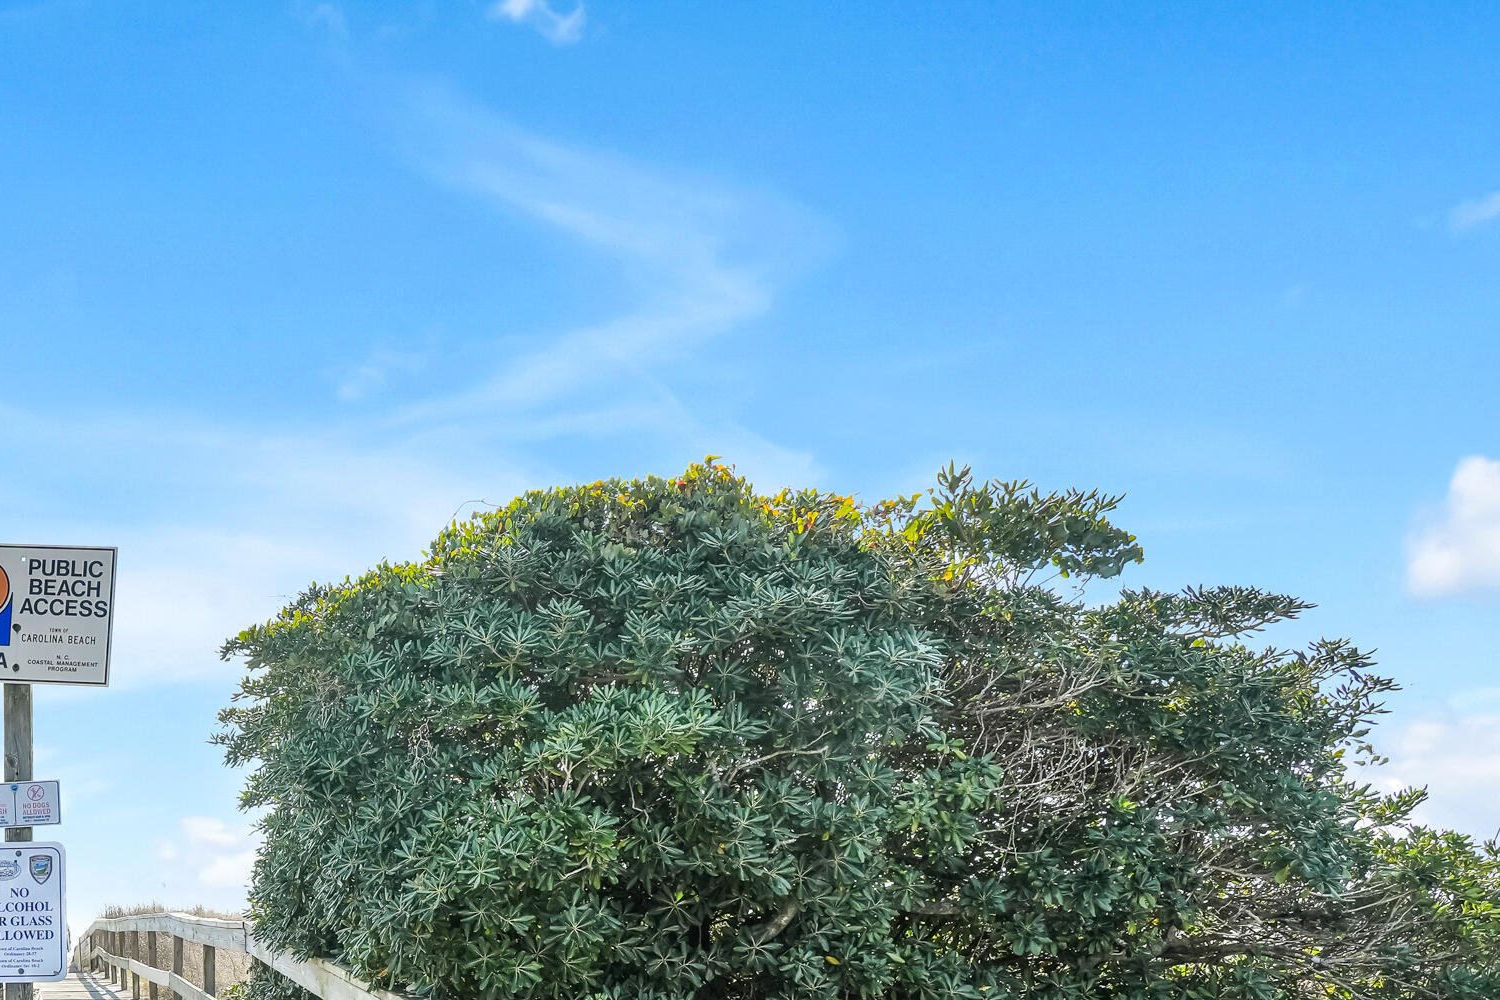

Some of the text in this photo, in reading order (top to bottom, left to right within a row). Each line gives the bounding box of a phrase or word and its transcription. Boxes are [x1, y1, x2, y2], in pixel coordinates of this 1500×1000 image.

[28, 558, 104, 578] PUBLIC
[29, 578, 101, 598] BEACH
[19, 597, 108, 618] ACCESS
[21, 633, 97, 645] CAROLINA BEACH
[56, 660, 98, 668] MANAGEMENT
[10, 888, 29, 898] NO
[10, 916, 52, 926] GLASS
